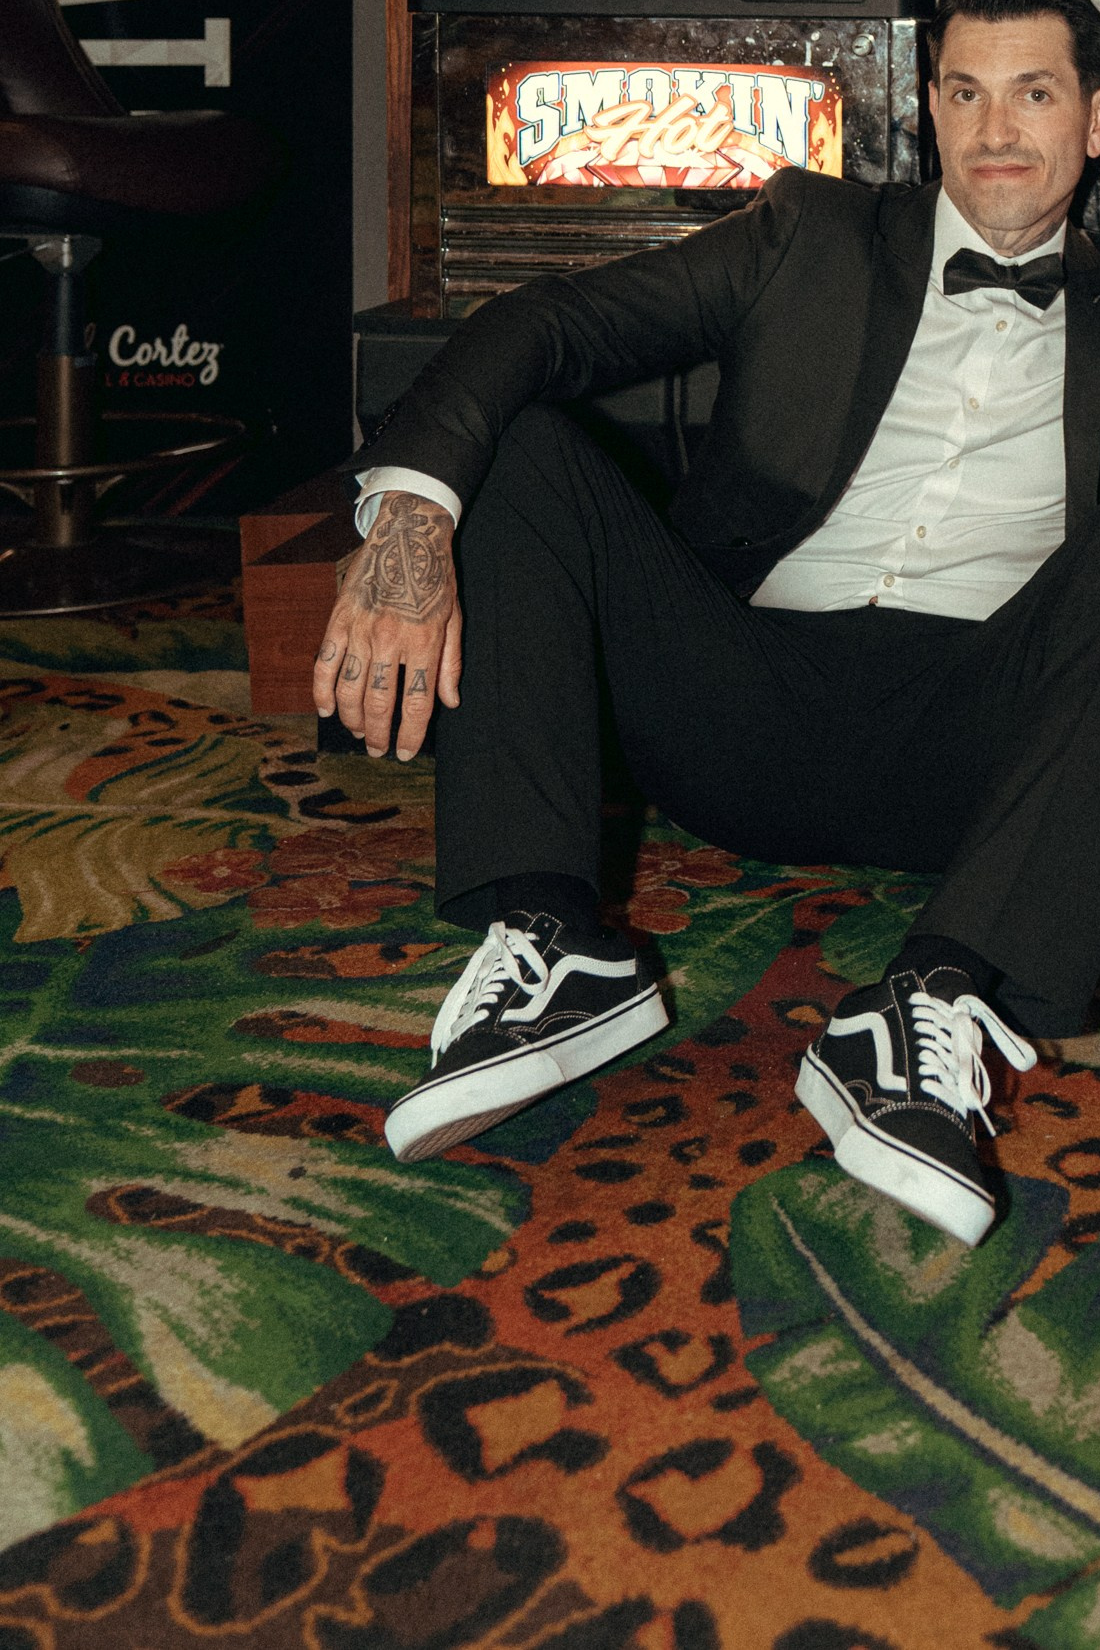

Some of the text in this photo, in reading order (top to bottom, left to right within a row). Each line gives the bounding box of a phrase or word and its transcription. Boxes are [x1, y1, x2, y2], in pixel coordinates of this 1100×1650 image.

[515, 67, 825, 168] SMOKIN'
[583, 93, 734, 162] Hot
[108, 322, 220, 387] Cortez
[134, 372, 196, 388] CASINO
